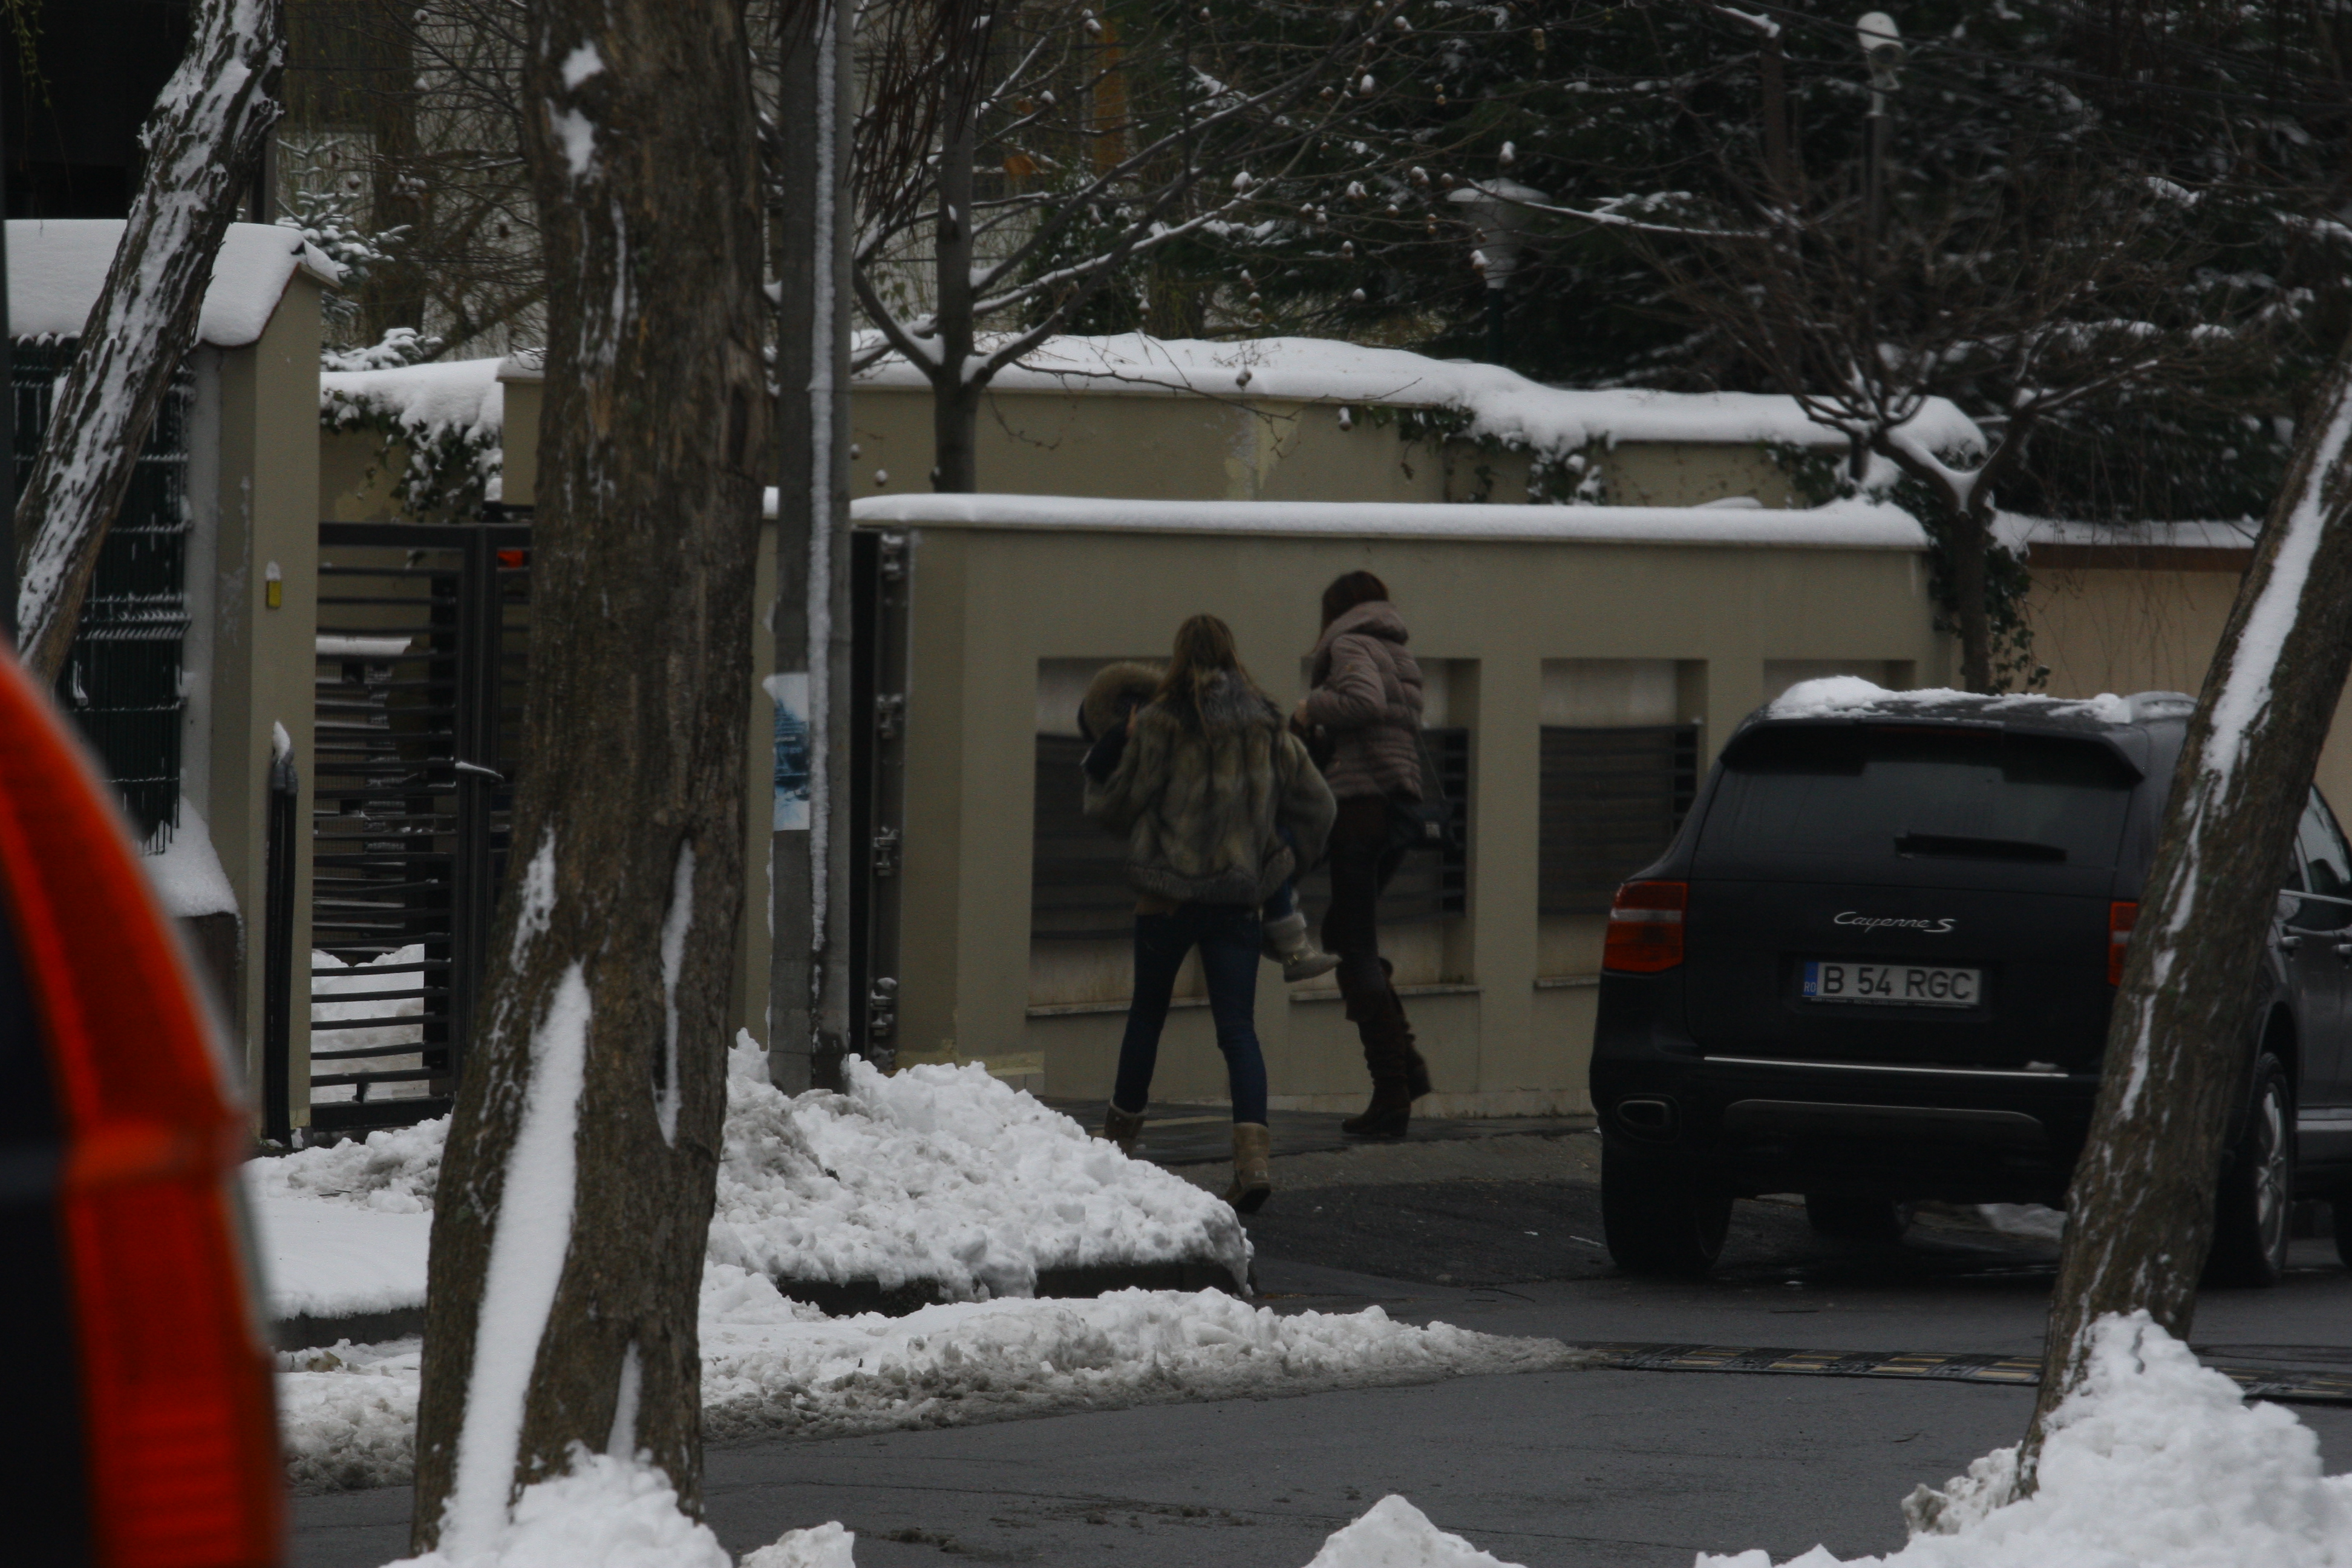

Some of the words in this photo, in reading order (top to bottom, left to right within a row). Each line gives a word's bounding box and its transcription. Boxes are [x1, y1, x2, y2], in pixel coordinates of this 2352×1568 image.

[1834, 912, 1929, 933] Cayenne
[1923, 918, 1958, 933] S
[1804, 981, 1816, 993] RO
[1823, 966, 1844, 994] B
[1858, 967, 1892, 996] 54
[1906, 969, 1972, 999] RGC
